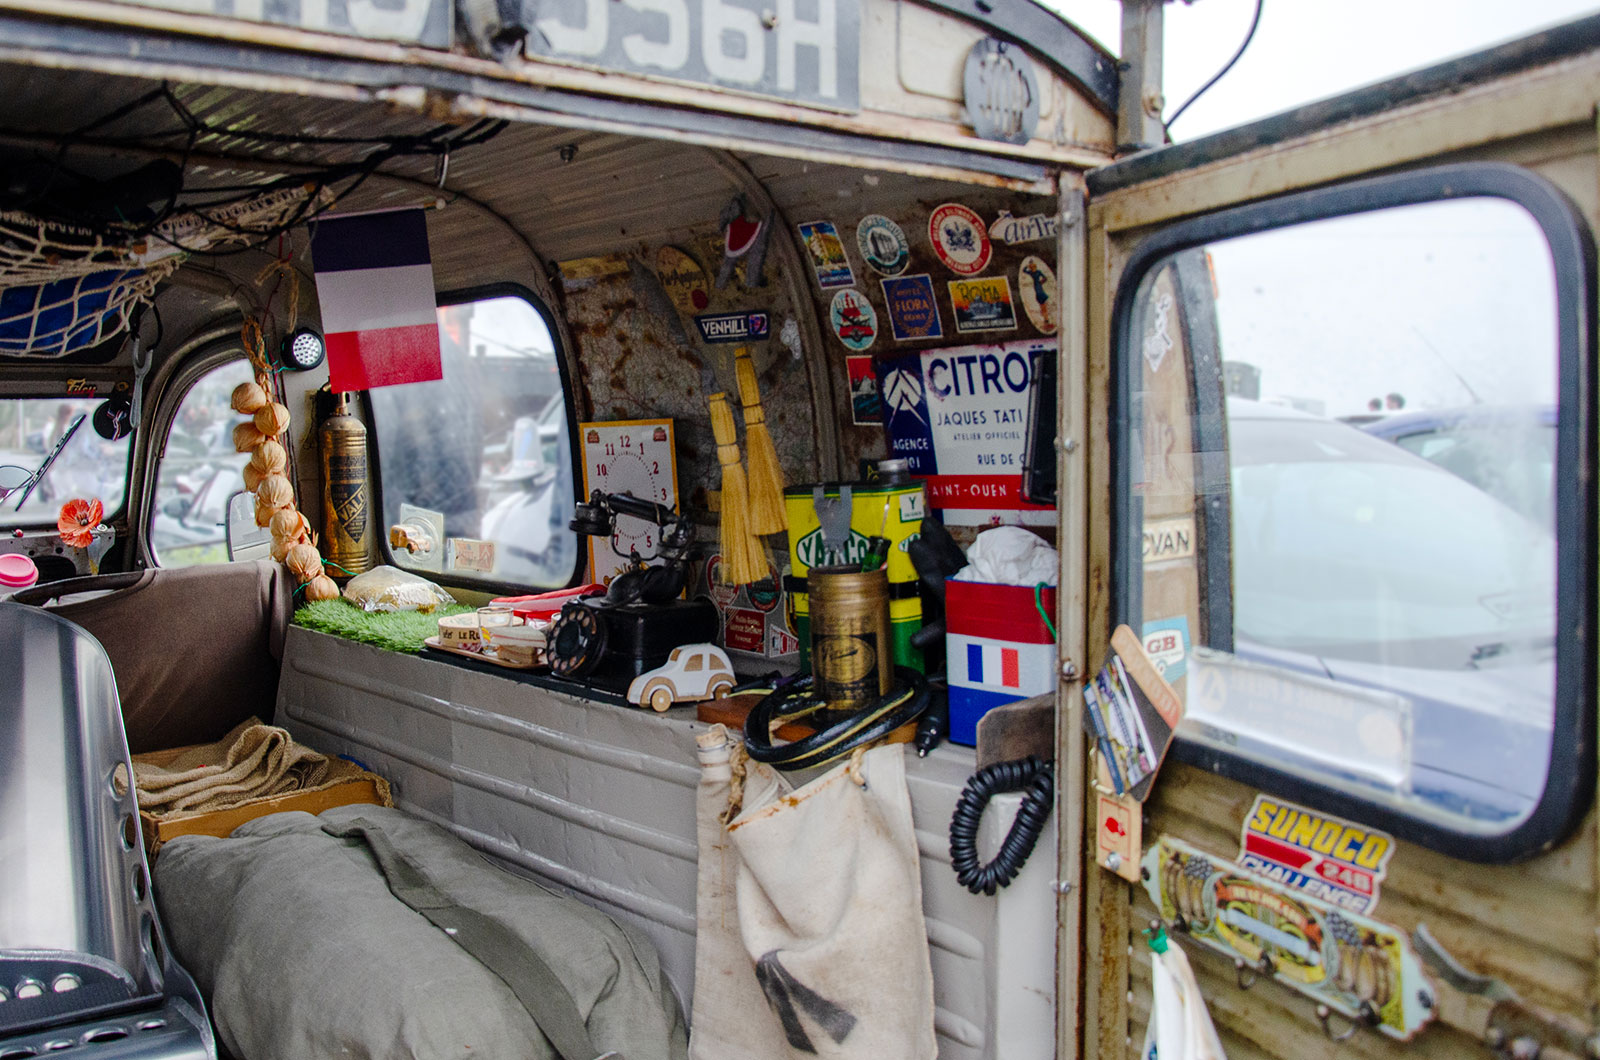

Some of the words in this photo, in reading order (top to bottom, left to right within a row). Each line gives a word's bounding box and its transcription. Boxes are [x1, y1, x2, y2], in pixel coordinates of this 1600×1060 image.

[895, 299, 929, 312] FLORA
[701, 318, 748, 336] VENHILL
[928, 344, 1045, 398] CITRO
[937, 411, 987, 426] JAQUES
[993, 409, 1023, 423] TATI
[620, 435, 631, 448] 12
[953, 432, 981, 441] ATELIER
[985, 431, 1021, 440] OFFICIEL
[605, 443, 615, 456] 11
[639, 443, 645, 455] 1
[893, 437, 929, 451] AGENCE
[977, 454, 996, 465] RUE
[1001, 454, 1014, 465] DE
[596, 463, 607, 476] 10
[653, 461, 659, 475] 2
[660, 488, 667, 501] 3
[930, 483, 1007, 497] AINT-OUEN
[909, 496, 916, 510] Y
[645, 535, 652, 548] 5
[802, 531, 870, 569] YACO
[458, 631, 468, 640] LE
[1146, 635, 1177, 654] GB
[1249, 800, 1390, 870] SUNOCO
